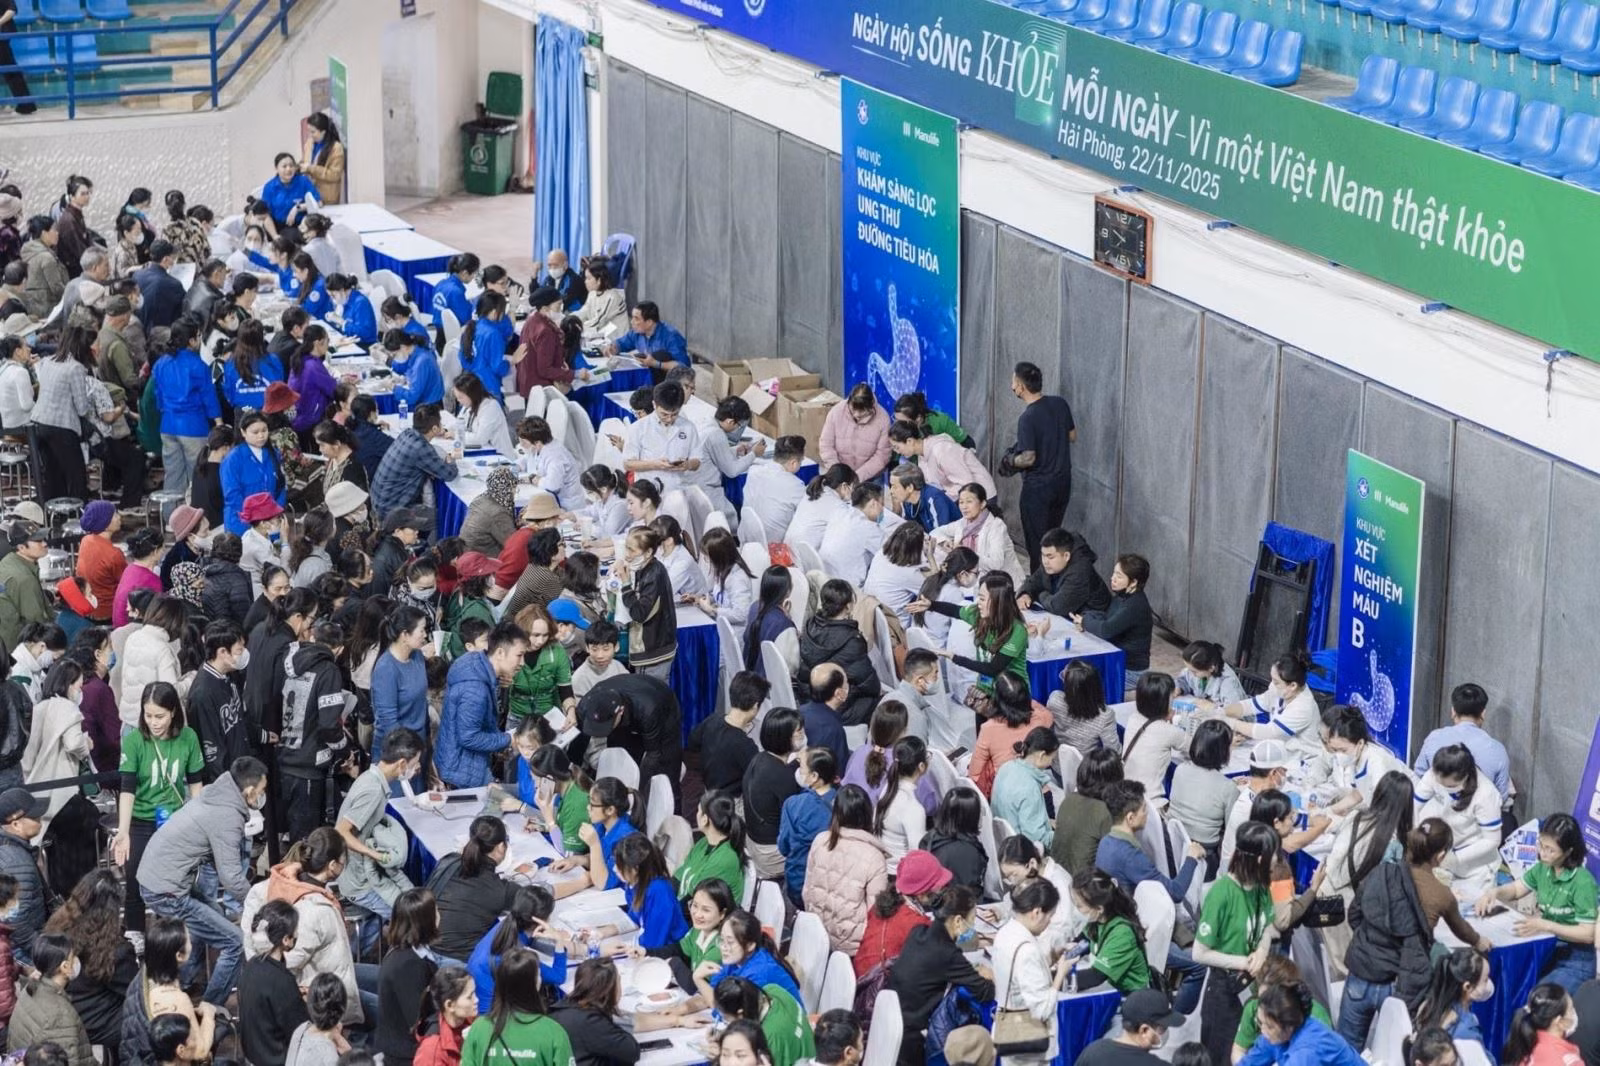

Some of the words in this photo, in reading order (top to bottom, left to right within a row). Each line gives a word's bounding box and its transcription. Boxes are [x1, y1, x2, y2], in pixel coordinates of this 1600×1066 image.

[852, 12, 889, 47] NGÀY
[890, 23, 915, 61] HỘI
[917, 16, 972, 76] SỐNG
[976, 30, 1059, 105] KHỎE
[1062, 67, 1108, 124] MỖI
[1111, 92, 1179, 146] NGÀY
[1190, 115, 1210, 160] Vì
[1215, 133, 1264, 184] một
[1271, 142, 1317, 203] Việt
[1321, 161, 1383, 223] Nam
[1391, 187, 1449, 250] thật
[1453, 205, 1525, 273] khỏe
[914, 126, 940, 147] Manulife
[856, 145, 869, 162] KHU
[869, 150, 882, 168] VỰC
[1057, 119, 1081, 149] Hải
[1082, 128, 1126, 170] Phòng,
[1129, 145, 1221, 200] 22/11/2025
[857, 166, 886, 196] KHÁM
[887, 177, 915, 208] SÀNG
[916, 191, 937, 218] LỌC
[858, 193, 879, 220] UNG
[880, 203, 901, 229] THƯ
[857, 221, 893, 254] ĐƯỜNG
[893, 236, 916, 264] TIÊU
[917, 247, 940, 275] HÓA
[1356, 516, 1371, 534] KHU
[1371, 524, 1386, 542] VỰC
[1354, 536, 1378, 564] XÉT
[1353, 564, 1403, 605] NGHIỆM
[1353, 590, 1380, 620] MÁU
[1352, 616, 1365, 649] B
